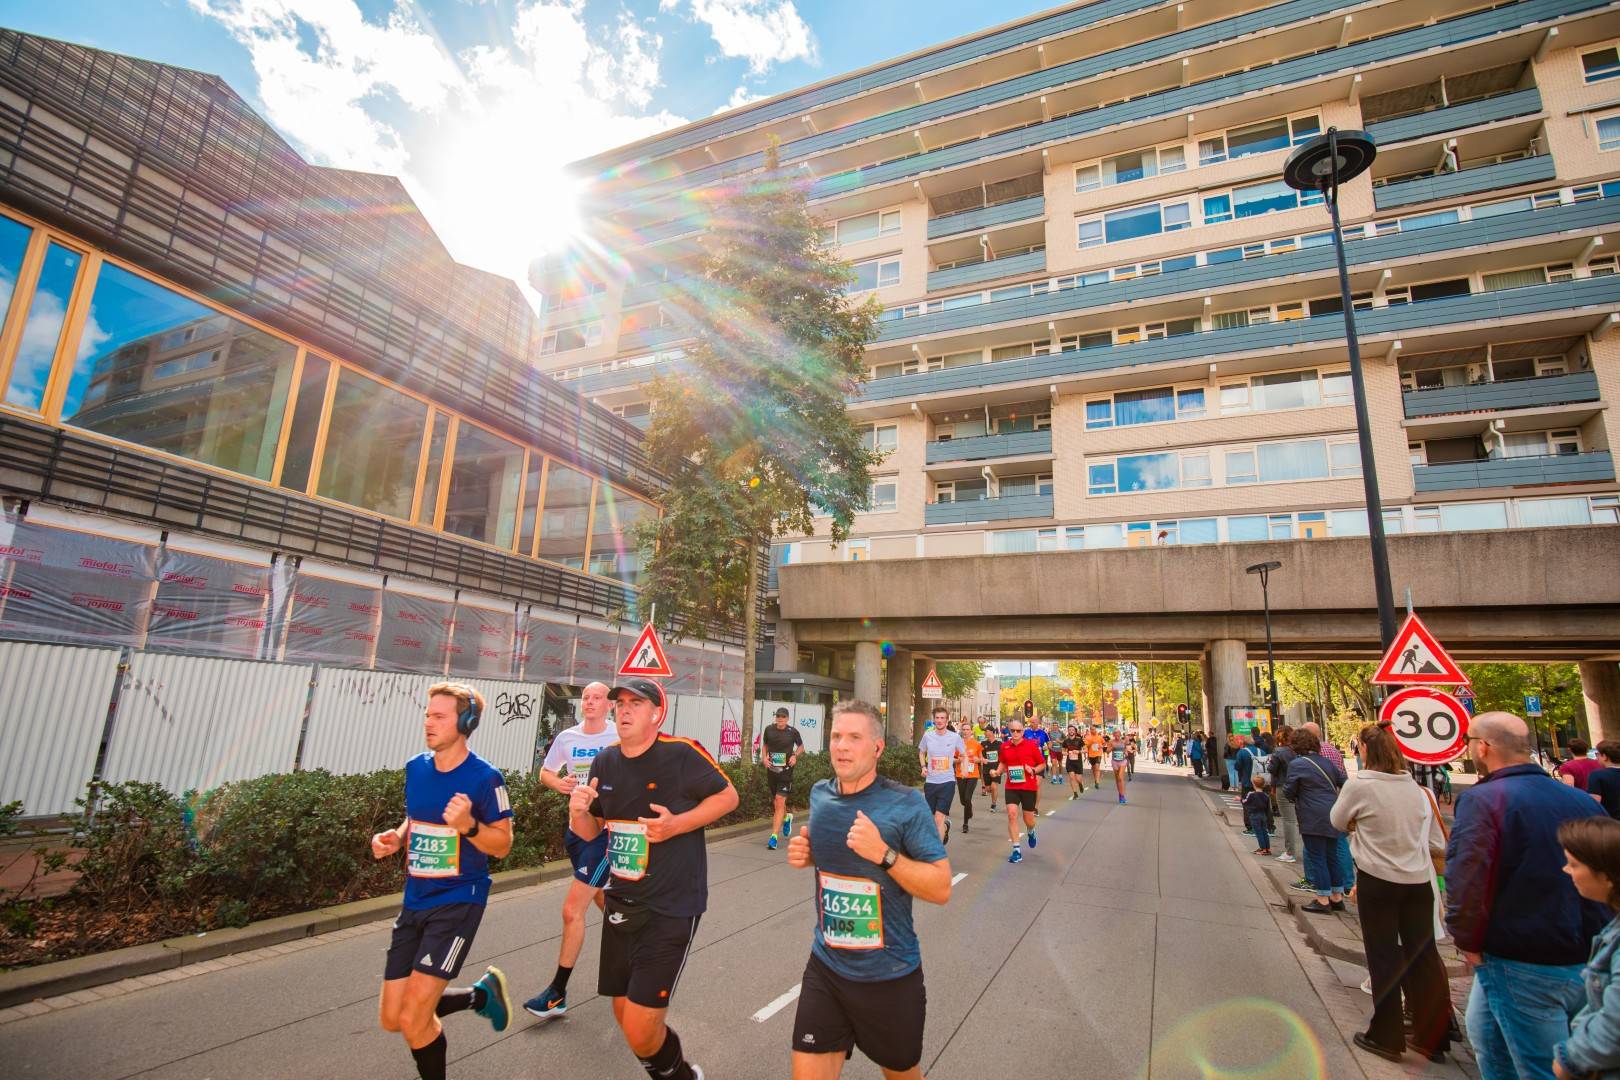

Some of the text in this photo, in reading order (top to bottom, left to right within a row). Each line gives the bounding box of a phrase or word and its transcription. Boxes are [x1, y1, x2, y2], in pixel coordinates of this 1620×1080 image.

[82, 559, 118, 570] miofol
[1396, 710, 1457, 741] 30
[572, 746, 604, 758] isa
[415, 837, 449, 852] 2183
[613, 836, 639, 852] 2372
[618, 855, 630, 864] ROB
[823, 893, 873, 916] 16344
